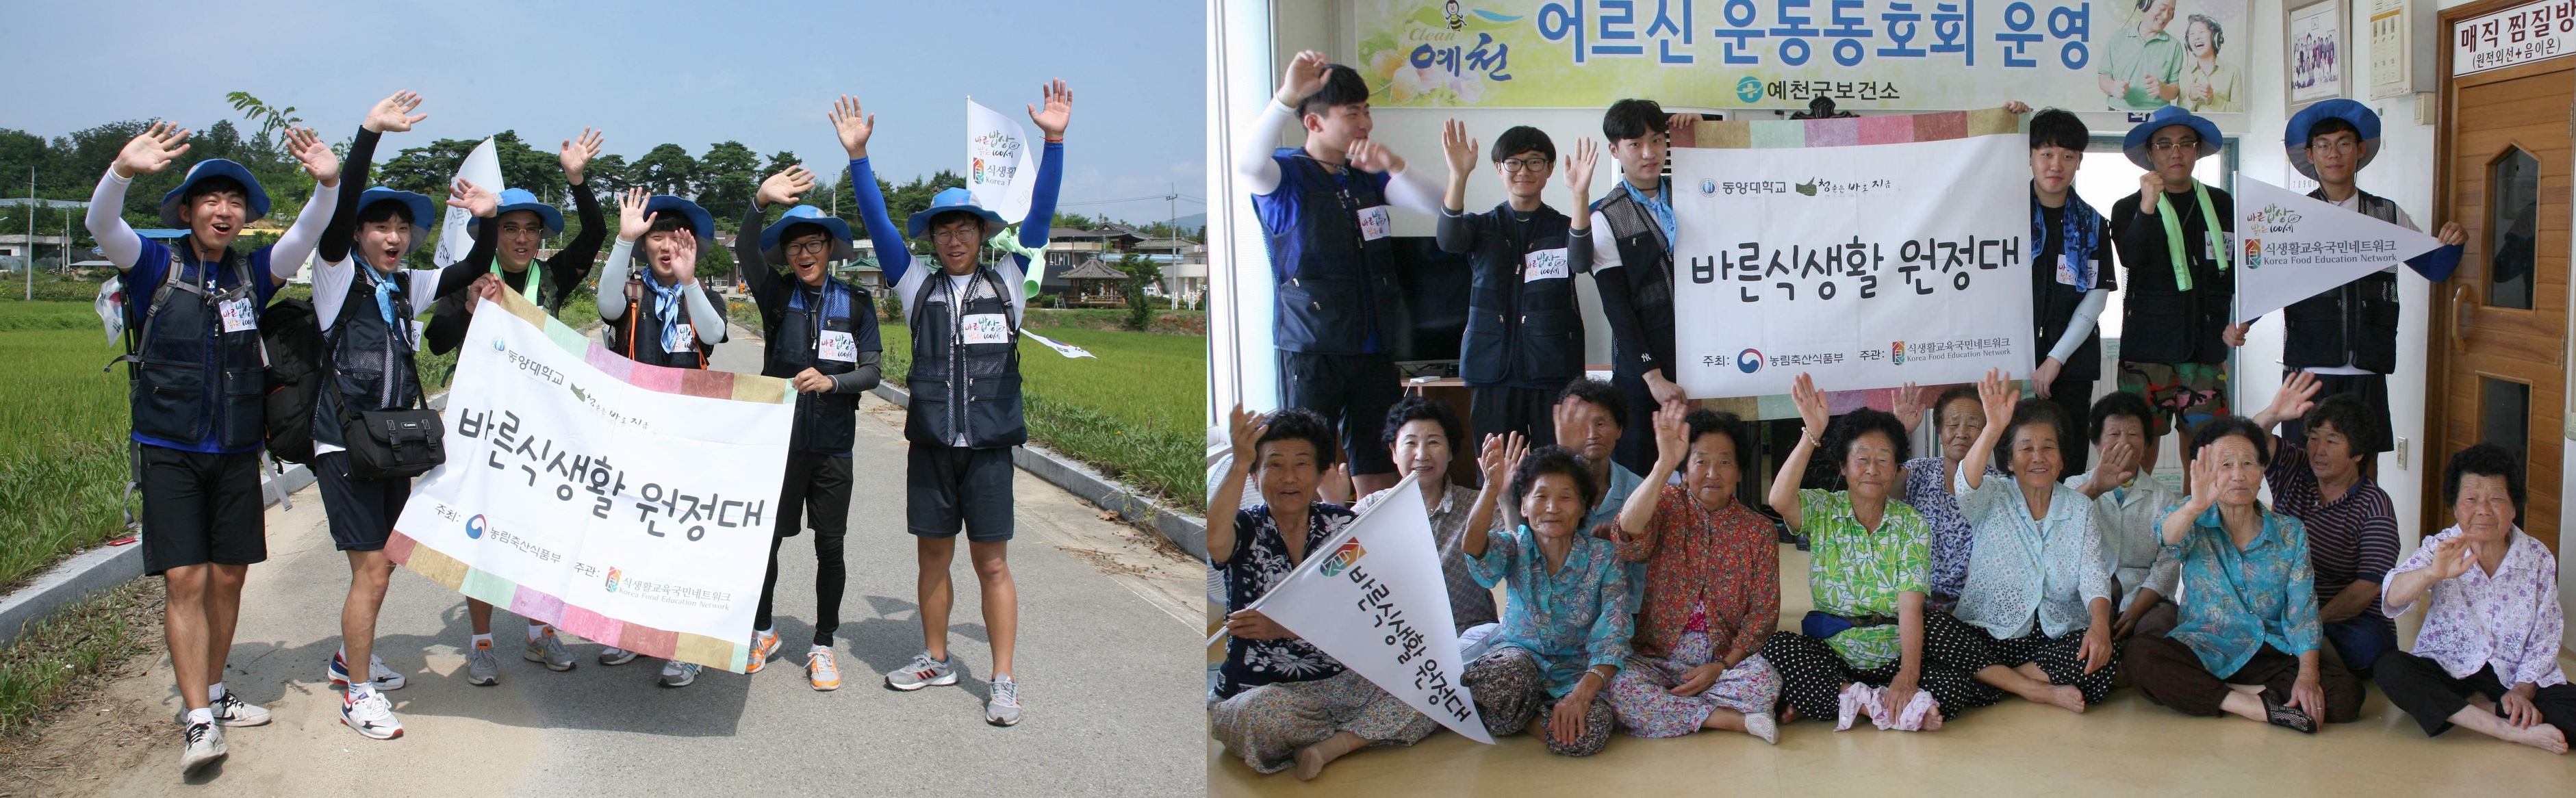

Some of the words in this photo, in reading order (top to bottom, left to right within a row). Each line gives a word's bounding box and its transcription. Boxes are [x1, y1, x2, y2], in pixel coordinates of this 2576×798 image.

[1409, 28, 1455, 41] Clean
[1538, 0, 1694, 64] 어르신
[1714, 0, 1974, 67] 운동동호회
[1995, 1, 2090, 70] 운영
[2460, 19, 2499, 53] 매직
[2508, 0, 2576, 43] 찜질방
[1410, 33, 1512, 81] 예천
[1767, 80, 1900, 100] 예천군보건소
[975, 136, 989, 145] 바른
[989, 130, 1015, 148] 밥상
[986, 177, 1005, 186] Korea
[1722, 181, 1786, 194] 동양대학교
[1818, 178, 1845, 193] 청춘은
[1848, 179, 1868, 192] 바로
[1872, 179, 1891, 189] 지금
[2247, 211, 2265, 222] 바른
[2264, 203, 2295, 223] 밥상
[2264, 239, 2397, 256] 식생활교육국민네트워크
[1537, 252, 1559, 268] 밥상
[2264, 257, 2288, 265] Korea
[2291, 255, 2312, 264] Food
[2315, 255, 2358, 264] Education
[2361, 253, 2397, 263] Network
[1691, 235, 1885, 303] 바른식생활
[1898, 235, 2019, 296] 원정대
[965, 322, 979, 331] 바른
[978, 316, 999, 332] 밥상
[821, 339, 835, 347] 바른
[835, 334, 854, 350] 밥상
[1907, 337, 2011, 355] 식생활교육국민네트워크
[1703, 355, 1730, 367] 주최:
[1770, 352, 1844, 367] 농림축산식품부
[1859, 350, 1885, 361] 주관:
[1907, 354, 1926, 362] Korea
[1928, 352, 1945, 361] Food
[1948, 350, 1982, 359] Education
[1983, 348, 2011, 357] Network
[508, 349, 564, 385] 동양대학교
[458, 408, 626, 519] 바른식생활
[635, 482, 765, 541] 원정대
[435, 503, 461, 522] 주최:
[489, 527, 561, 563] 농림축산식품부
[574, 562, 600, 578] 주관:
[619, 587, 639, 598] Korea
[641, 593, 659, 601] Food
[661, 596, 697, 607] Education
[699, 601, 730, 610] Network
[622, 577, 731, 602] 식생활교육국민네트워크
[1349, 565, 1427, 665] 바른식생활
[1414, 659, 1471, 722] 원정대
